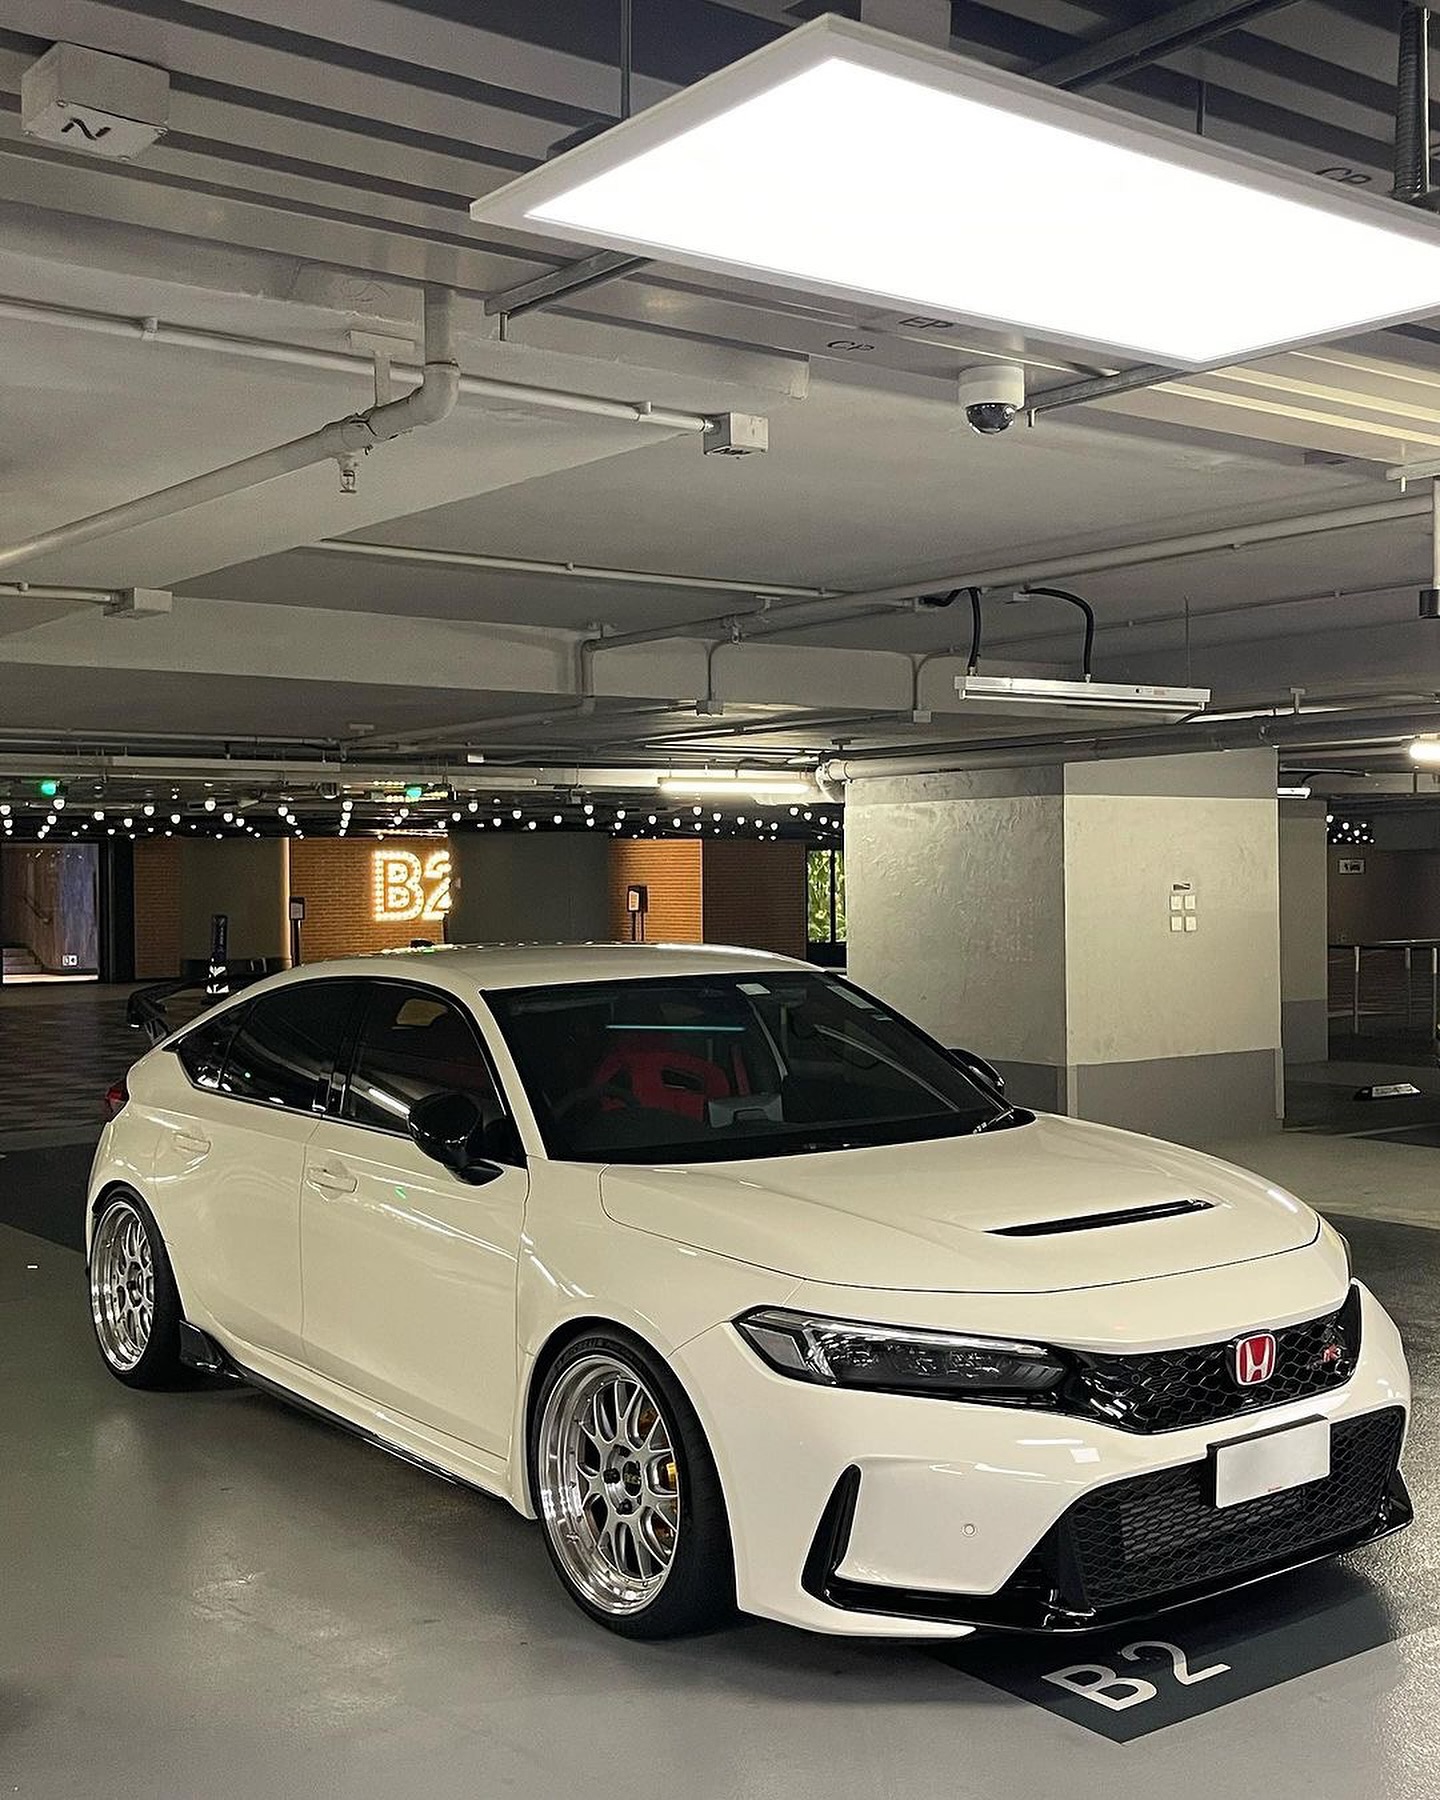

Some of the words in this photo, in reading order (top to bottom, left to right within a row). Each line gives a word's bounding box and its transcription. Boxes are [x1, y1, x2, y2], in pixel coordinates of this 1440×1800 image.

[1315, 167, 1372, 184] CP
[898, 315, 954, 329] EP
[827, 340, 875, 351] CP
[373, 850, 452, 921] B2
[1041, 1640, 1231, 1712] B2
